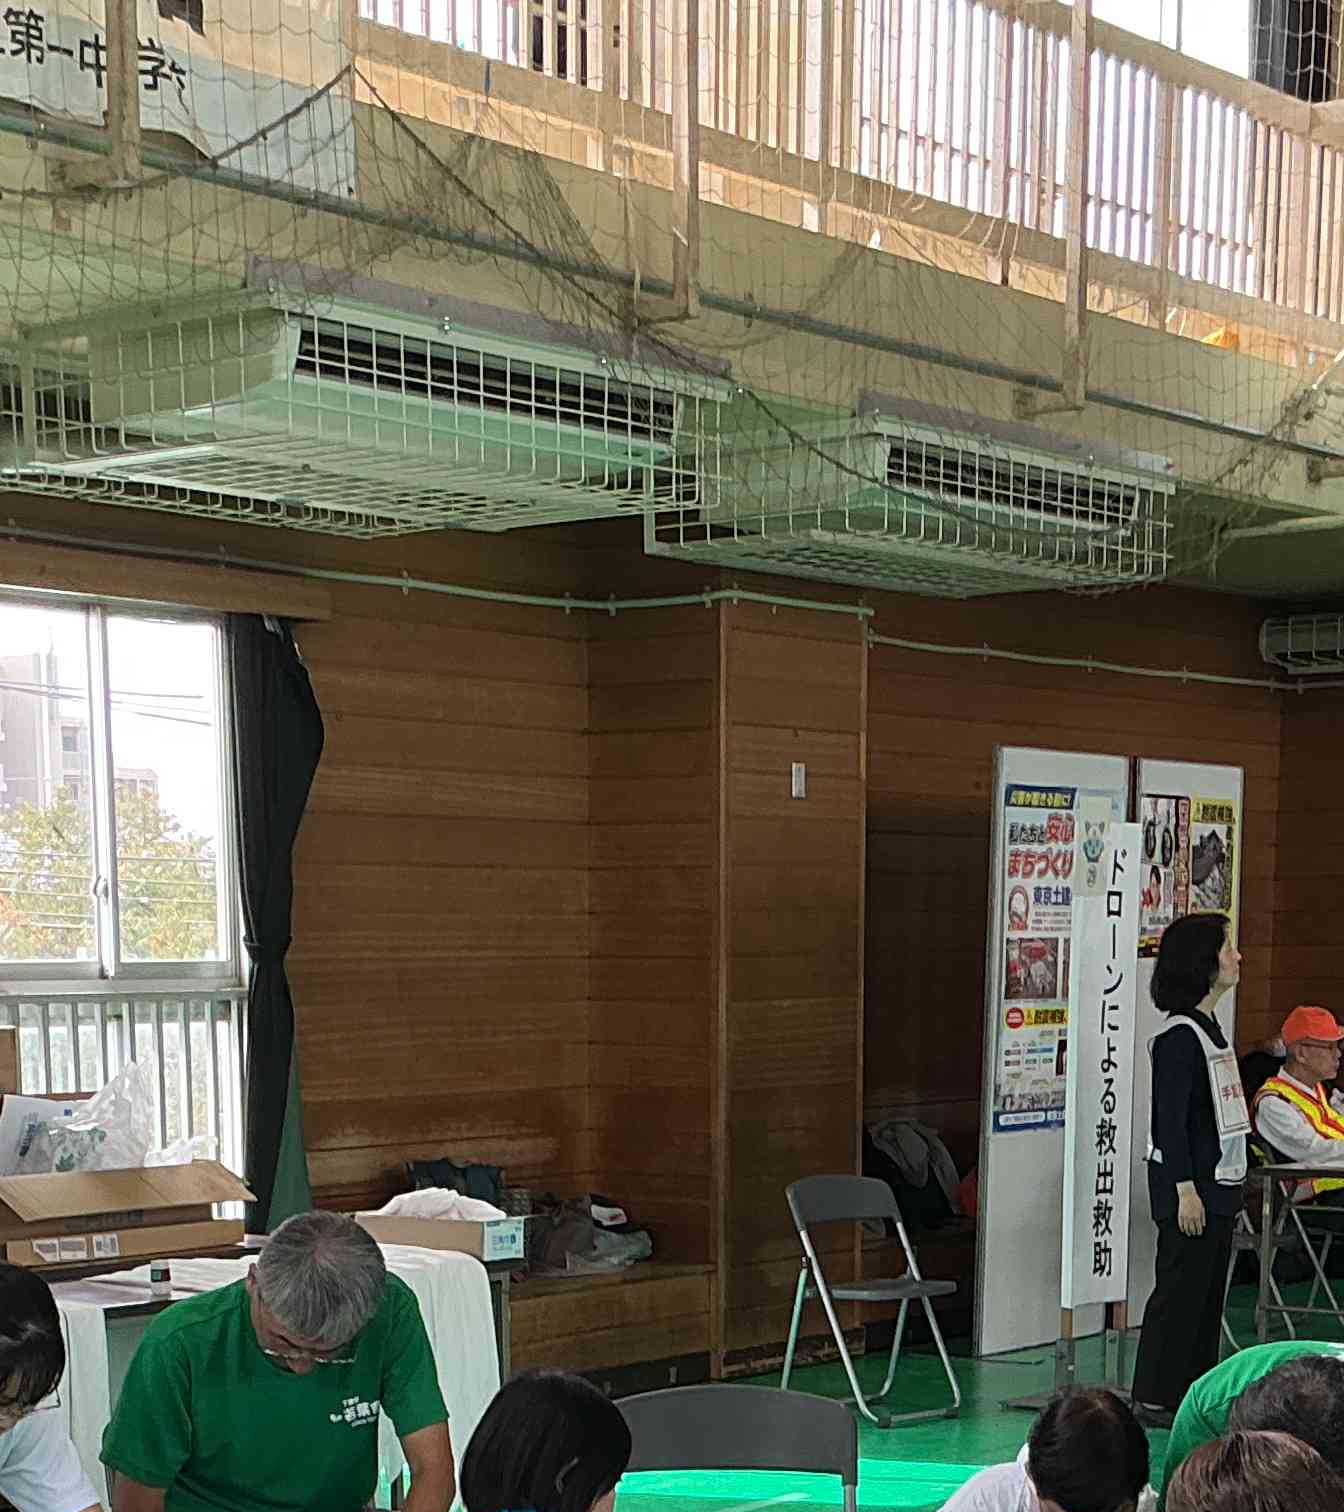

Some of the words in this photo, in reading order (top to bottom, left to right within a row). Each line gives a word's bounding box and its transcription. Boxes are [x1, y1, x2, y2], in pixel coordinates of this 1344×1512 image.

[1007, 847, 1075, 880] まちづくり
[1092, 848, 1129, 1278] ドローンによる救出救助
